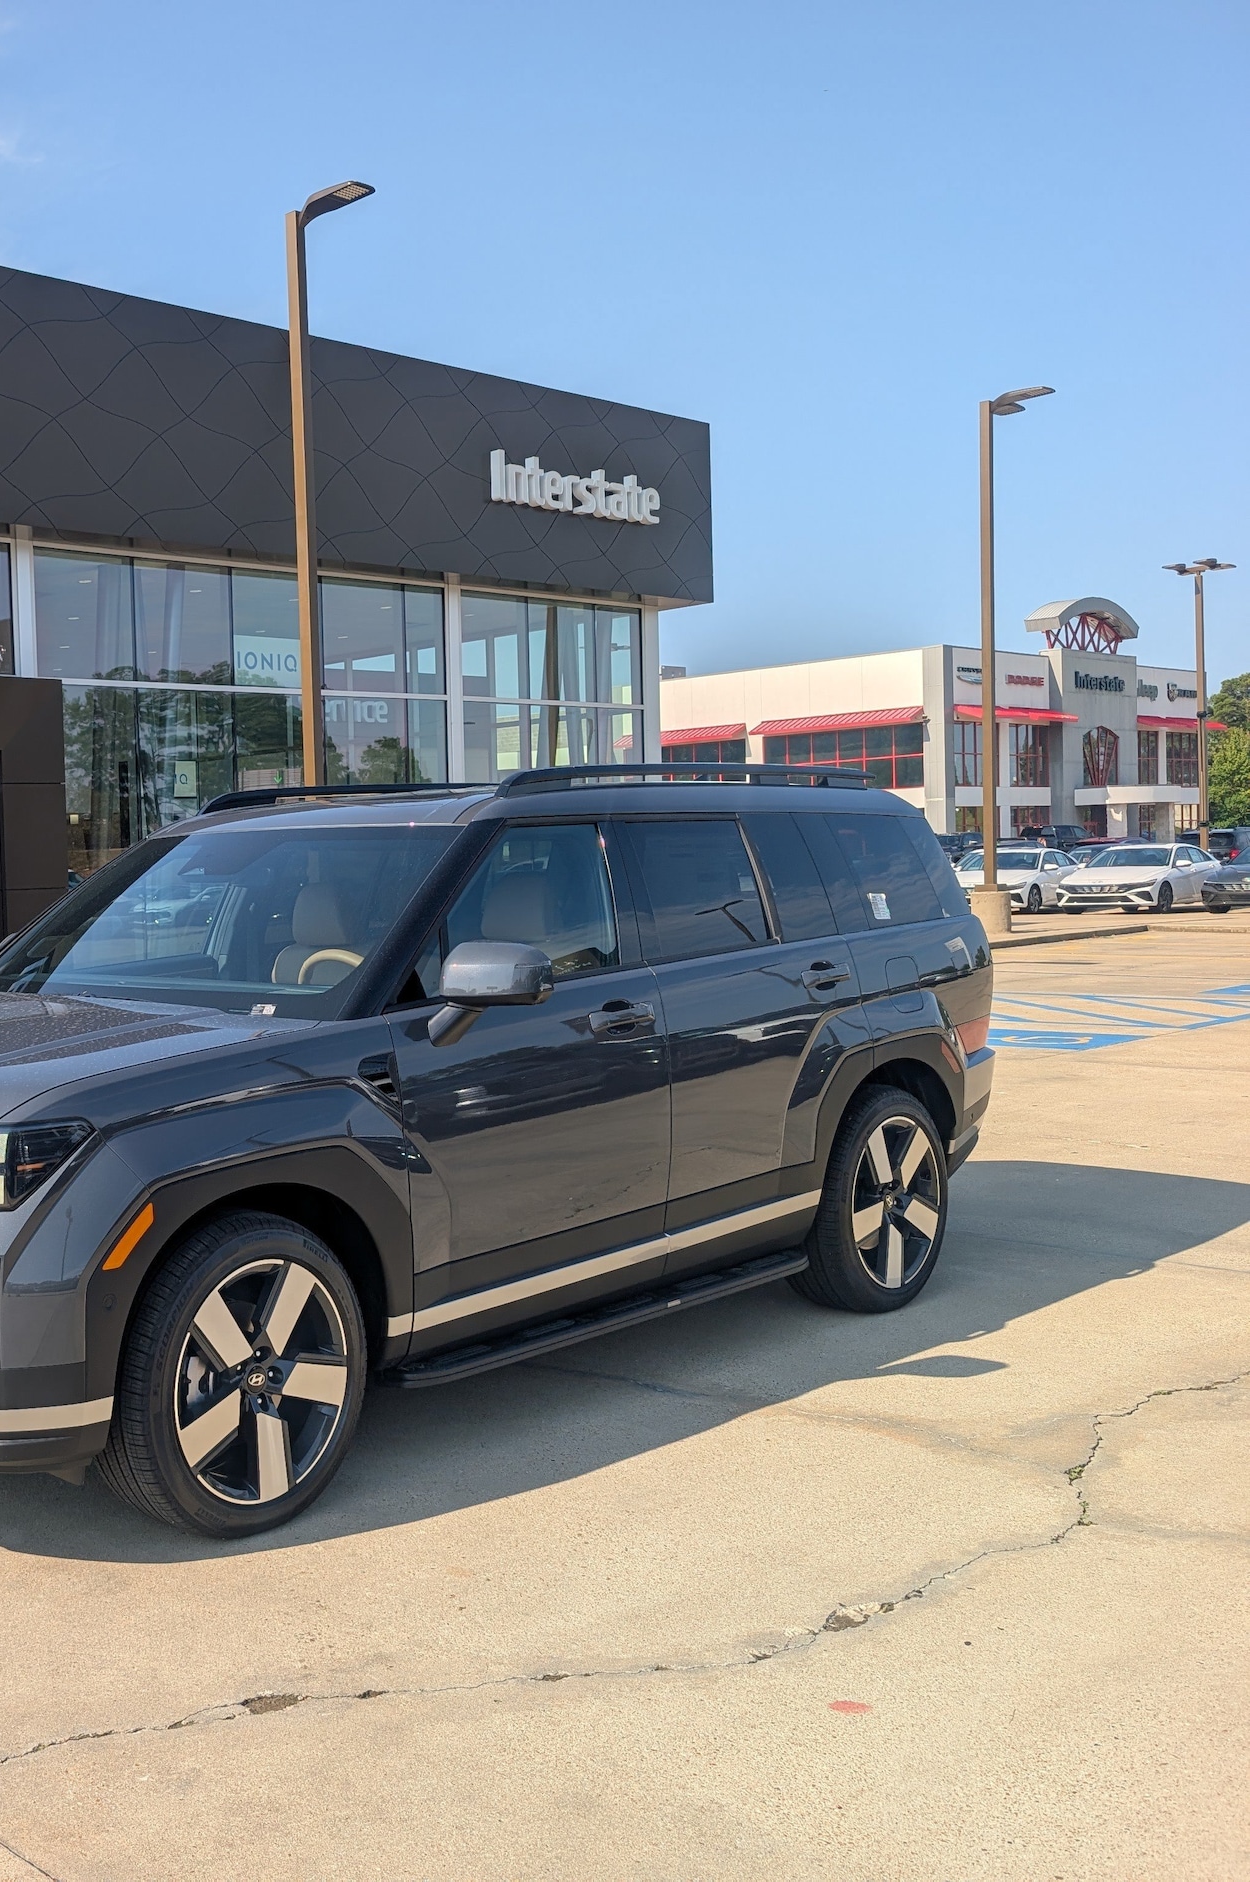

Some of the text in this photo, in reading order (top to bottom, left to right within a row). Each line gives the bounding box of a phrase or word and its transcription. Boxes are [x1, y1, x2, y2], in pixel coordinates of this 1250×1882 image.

[490, 448, 660, 526] Interstate
[237, 650, 298, 673] IONIQ
[1074, 670, 1126, 693] Interstate
[297, 697, 389, 724] rice
